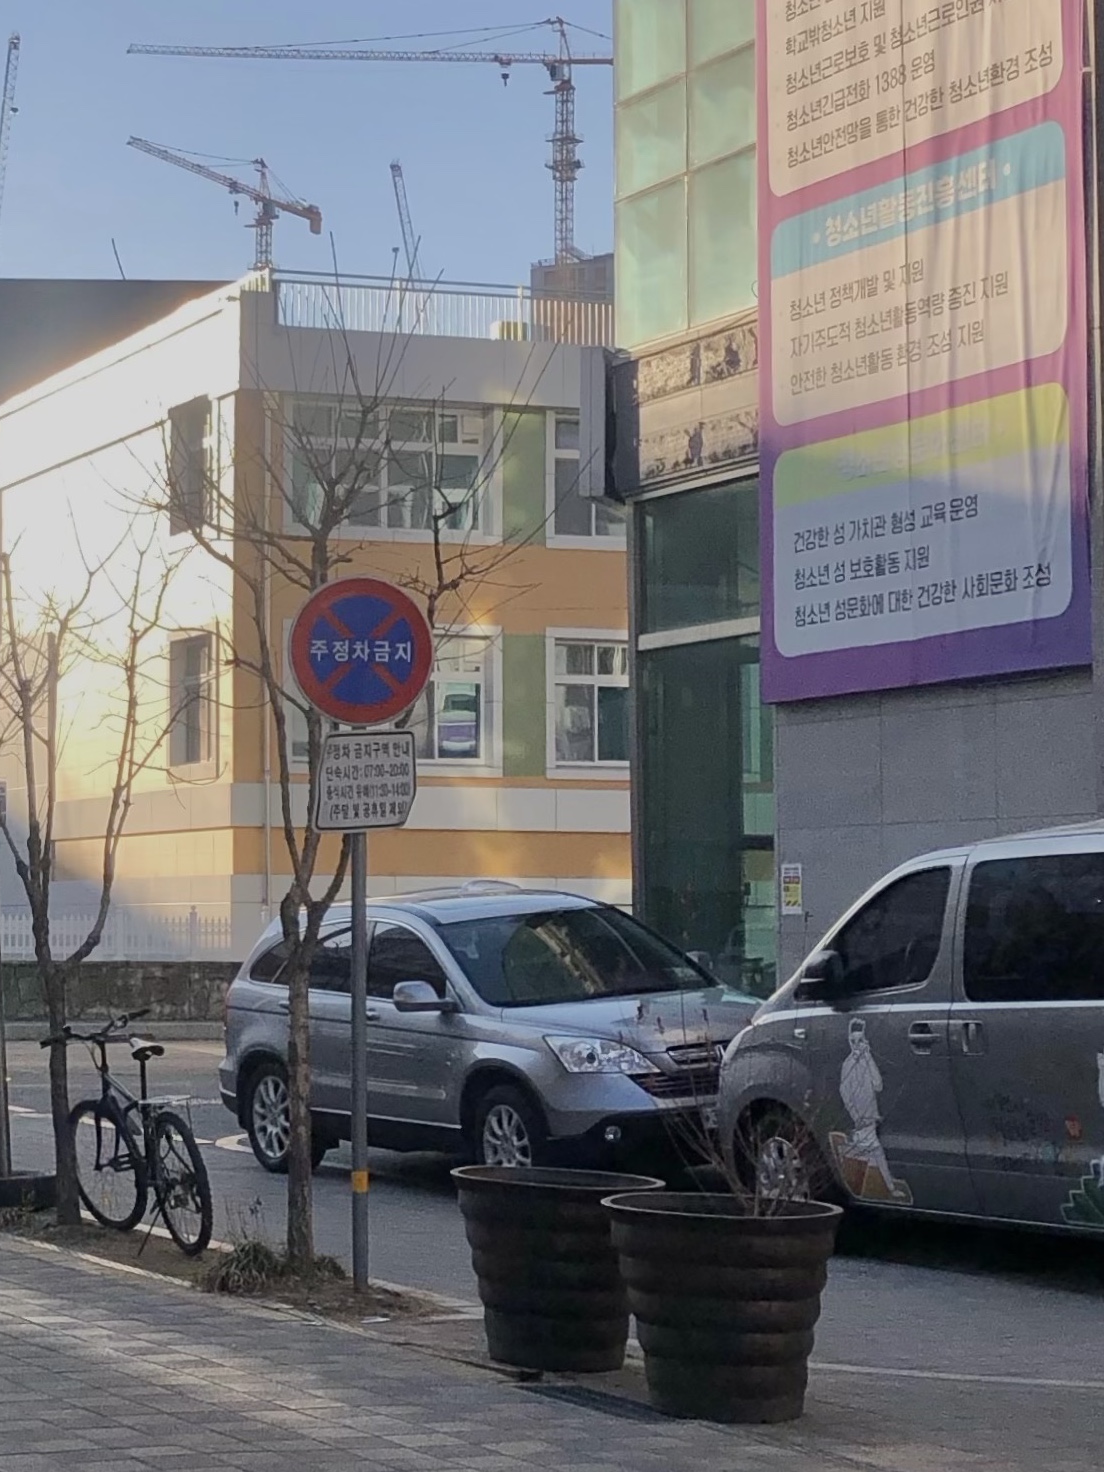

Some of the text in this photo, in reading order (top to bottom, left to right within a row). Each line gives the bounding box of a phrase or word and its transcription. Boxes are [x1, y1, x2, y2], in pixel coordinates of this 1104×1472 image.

[786, 0, 885, 56] 학교밖청소년 지원
[786, 41, 870, 95] 청소년근로보호
[873, 32, 886, 57] 및
[786, 49, 935, 132] 청소년긴급전화 1388 운영
[787, 40, 1053, 169] 청소년안전망을 통한 건강한 청소년환경 조성
[790, 291, 826, 322] 청소년
[829, 274, 878, 309] 정책개발
[883, 268, 895, 292] 및
[790, 321, 851, 358] 자기주도적
[948, 281, 976, 311] 증진
[980, 271, 1008, 301] 지원
[790, 366, 827, 396] 안전한
[830, 347, 893, 384] 청소년활동
[927, 328, 952, 358] 조성
[957, 319, 984, 348] 지원
[793, 494, 979, 553] 건강한 성 가치관 형성 교육 운영
[794, 545, 930, 591] 청소년 성 보호활동 지원
[794, 561, 1052, 627] 청소년 성문화에 대한 건강한 사회문화 조성
[310, 639, 412, 663] 주정차금지
